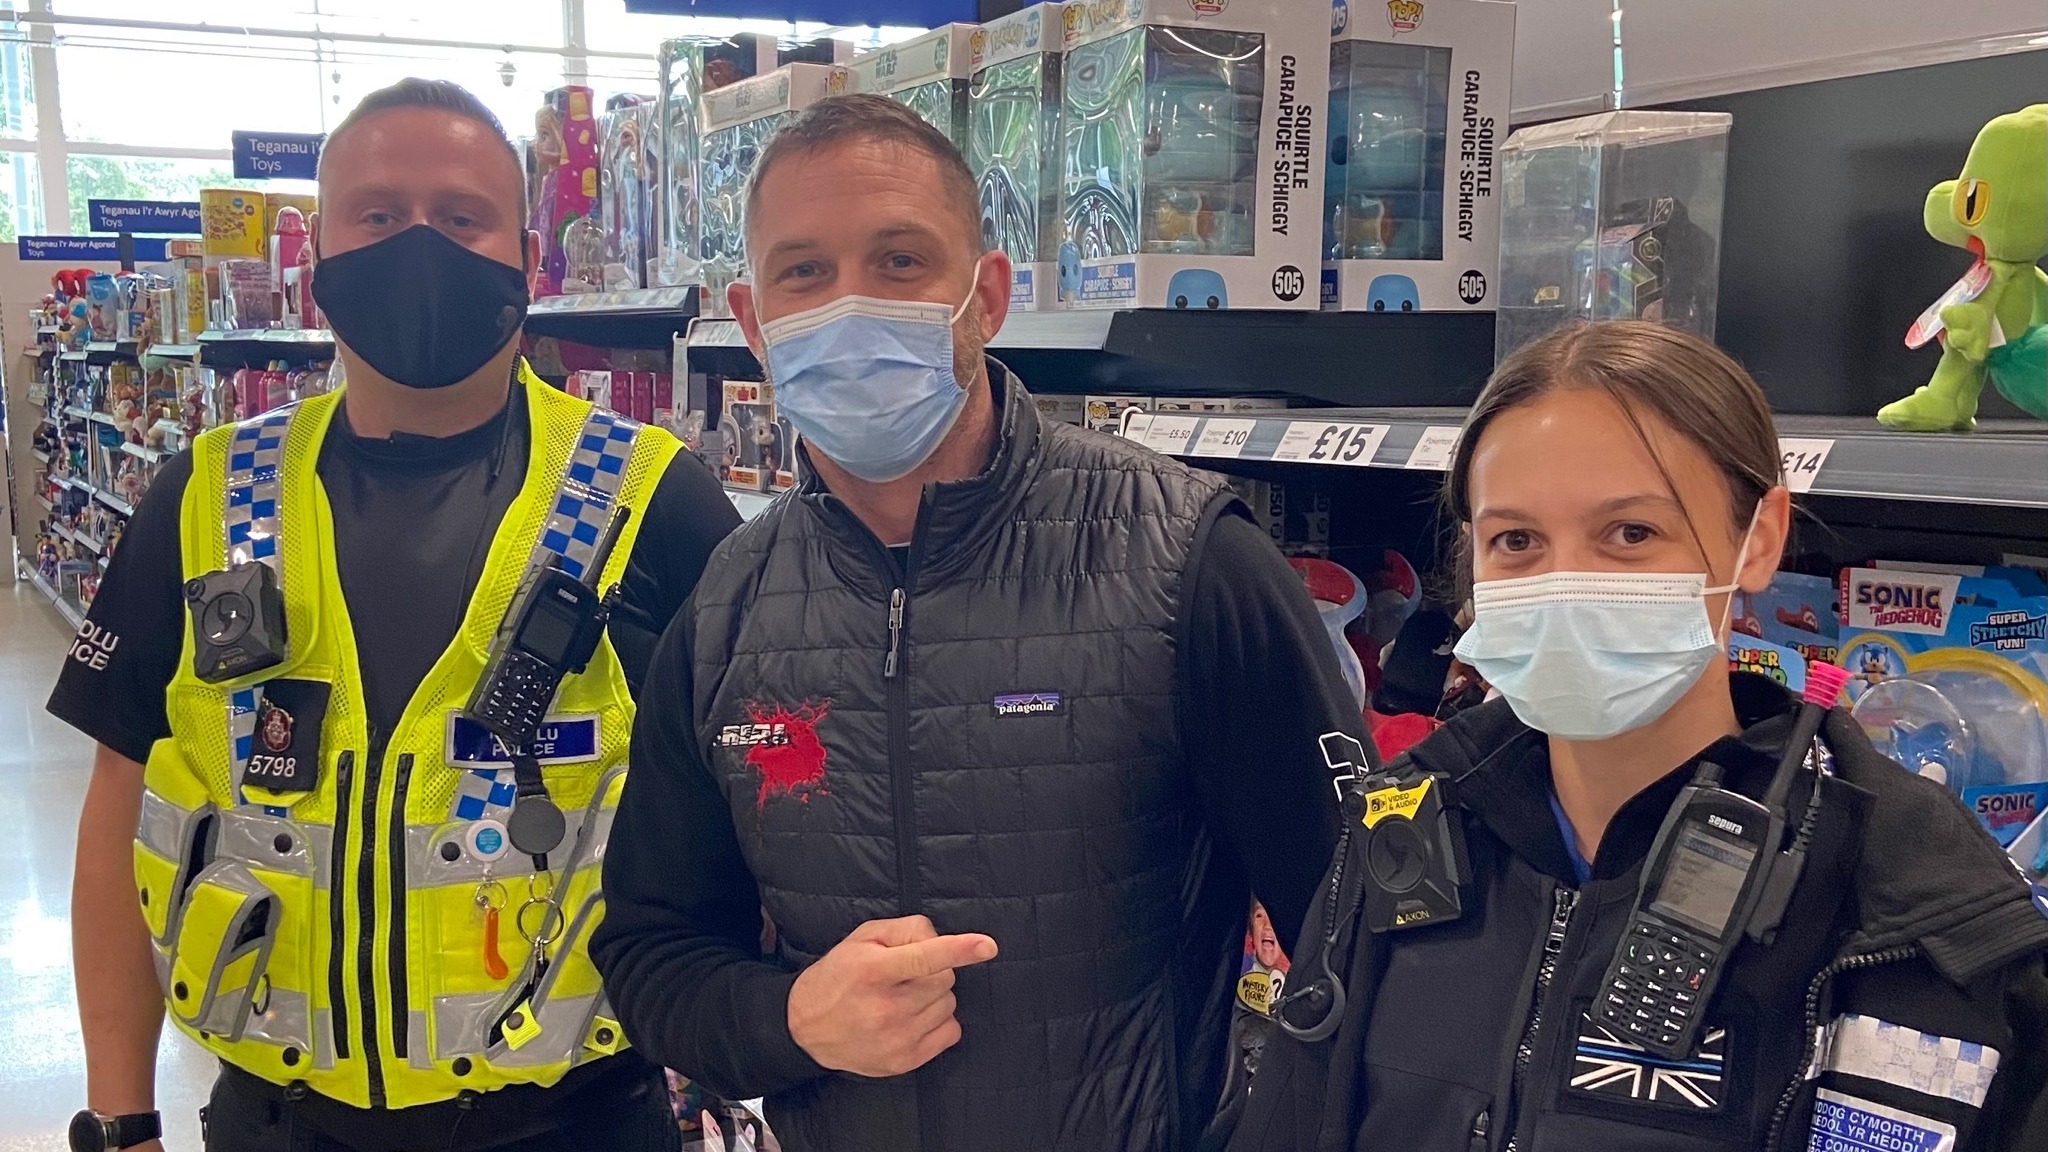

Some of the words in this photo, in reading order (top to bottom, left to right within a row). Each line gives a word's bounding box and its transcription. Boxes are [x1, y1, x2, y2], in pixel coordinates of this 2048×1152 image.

[1332, 6, 1347, 30] 05
[1275, 55, 1296, 151] CARAPUCE
[1460, 70, 1481, 161] CARAPUCE
[249, 138, 307, 156] Teganau
[311, 140, 320, 154] i'
[1292, 104, 1312, 189] SQUIRTLE
[1476, 116, 1494, 198] SQUIRTLE
[250, 156, 282, 173] Toys
[1272, 160, 1290, 237] SCHIGGY
[1458, 170, 1475, 243] SCHIGGY
[99, 204, 140, 218] Teganau
[154, 207, 178, 219] Awyr
[180, 207, 201, 219] Ago
[100, 216, 123, 228] Toys
[27, 239, 58, 249] Teganau
[88, 240, 116, 250] Agored
[28, 248, 45, 258] Toys
[1274, 271, 1301, 295] 505
[1460, 275, 1484, 299] 505
[1168, 429, 1192, 440] £5.50
[1222, 429, 1248, 446] £10
[1308, 425, 1375, 462] £15
[1782, 451, 1823, 474] £14
[1841, 580, 1849, 621] CLASSIC
[1856, 581, 1943, 610] SONIC
[1874, 606, 1943, 628] HEDGEHOG
[1989, 612, 2028, 625] SUPER
[77, 619, 119, 653] DLU
[1972, 616, 2047, 646] STRETCHY
[1996, 637, 2025, 649] FUN!
[68, 638, 110, 671] ICE
[1728, 644, 1780, 667] SUPER
[999, 701, 1054, 715] patagonia
[492, 743, 555, 757] POLCE
[248, 754, 296, 778] 5798
[1387, 792, 1410, 803] VIDEO
[1388, 802, 1395, 811] &
[1395, 798, 1418, 810] AUDIO
[1976, 792, 2036, 814] SONIC
[1706, 814, 1743, 836] sepura
[1404, 910, 1430, 923] AXON
[1242, 978, 1270, 994] MYSTERY
[1848, 1124, 1866, 1140] YR
[1849, 1111, 1926, 1144] CYMORTH
